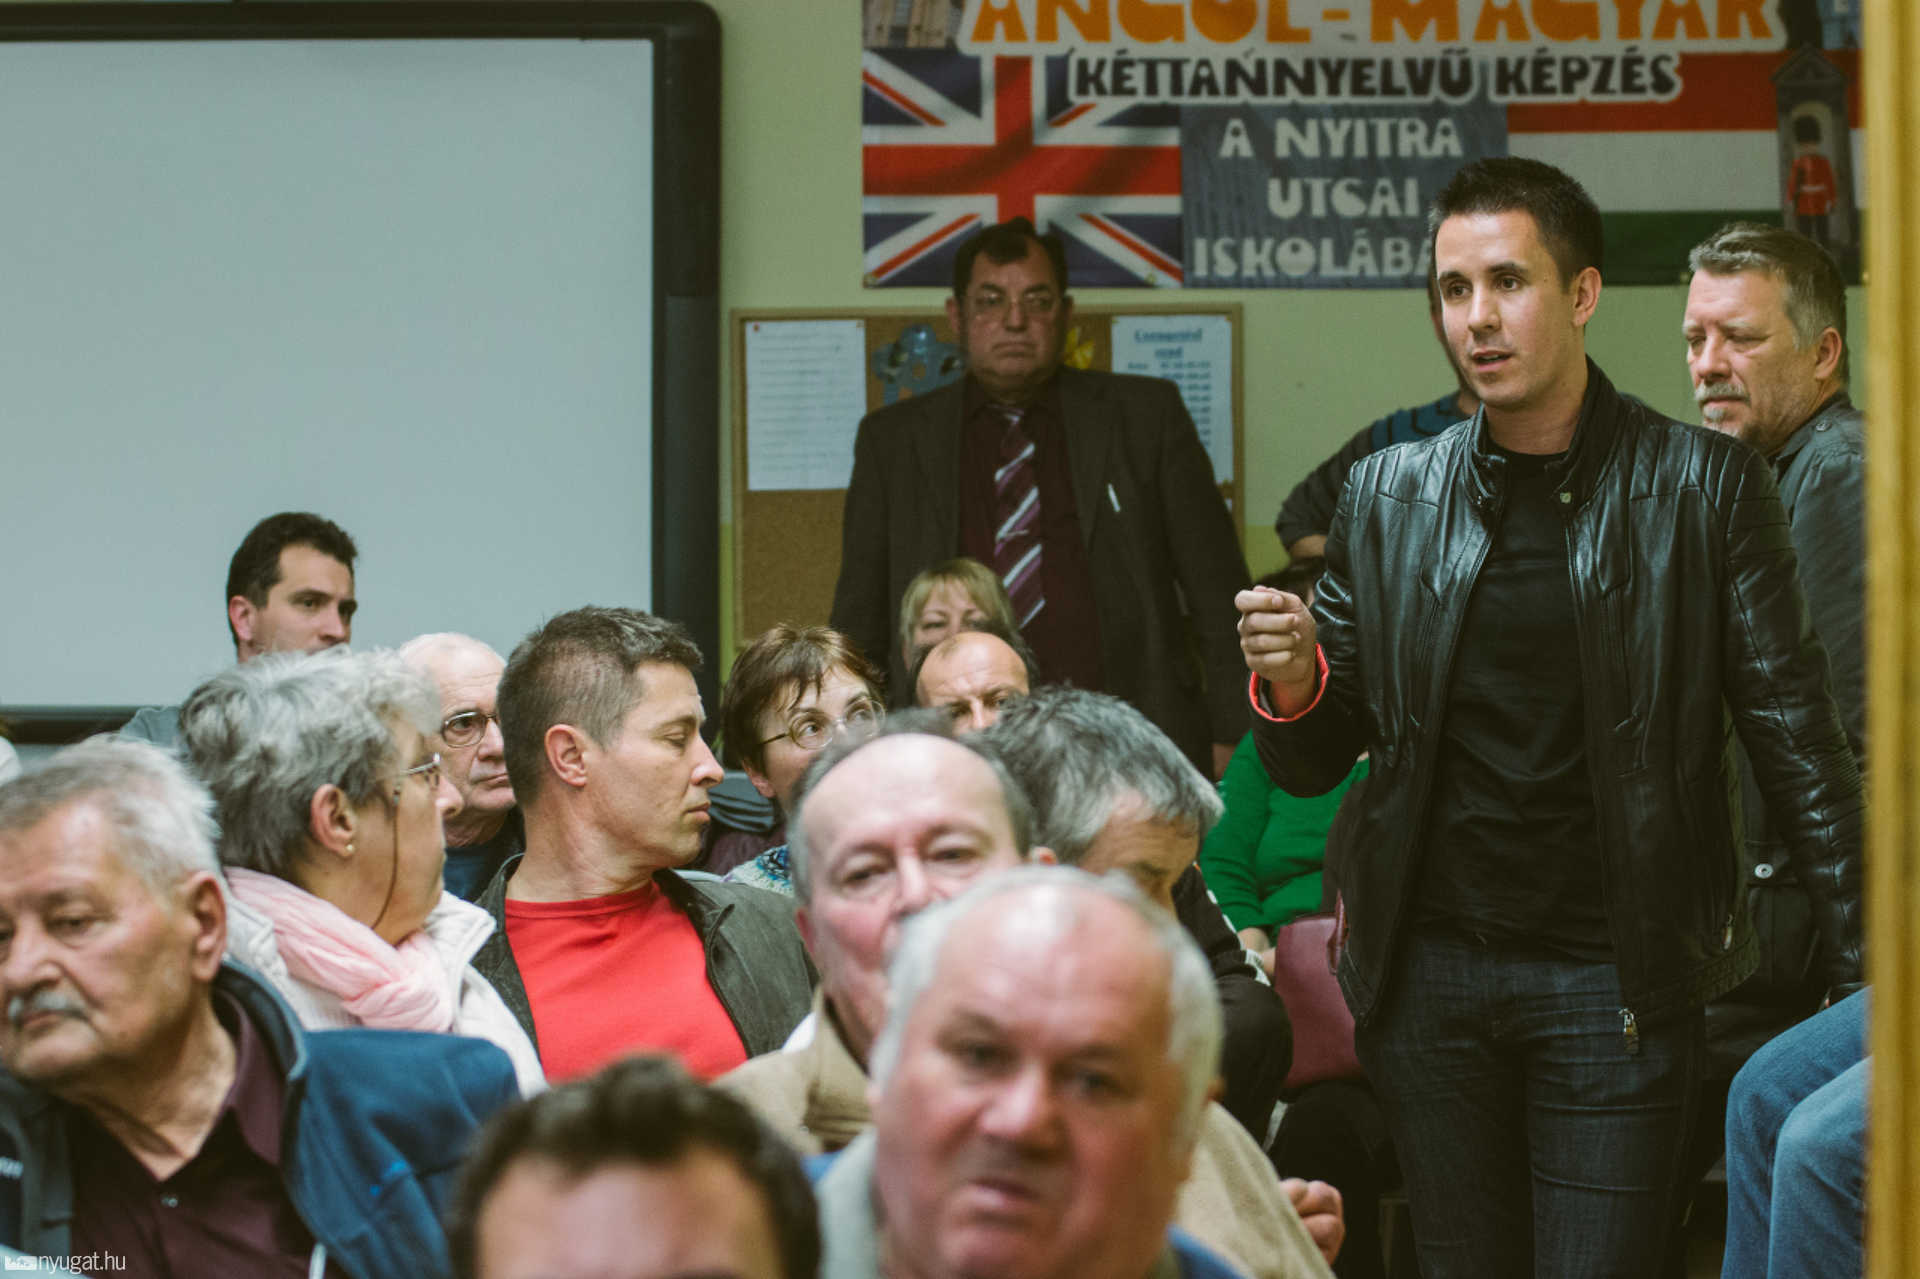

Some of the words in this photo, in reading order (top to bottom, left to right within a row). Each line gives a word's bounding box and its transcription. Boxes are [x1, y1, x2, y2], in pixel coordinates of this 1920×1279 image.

[1496, 46, 1677, 96] KÉPZÉS
[1219, 118, 1255, 158] A
[1274, 117, 1464, 158] NYITRA
[1267, 177, 1421, 219] UTCAI
